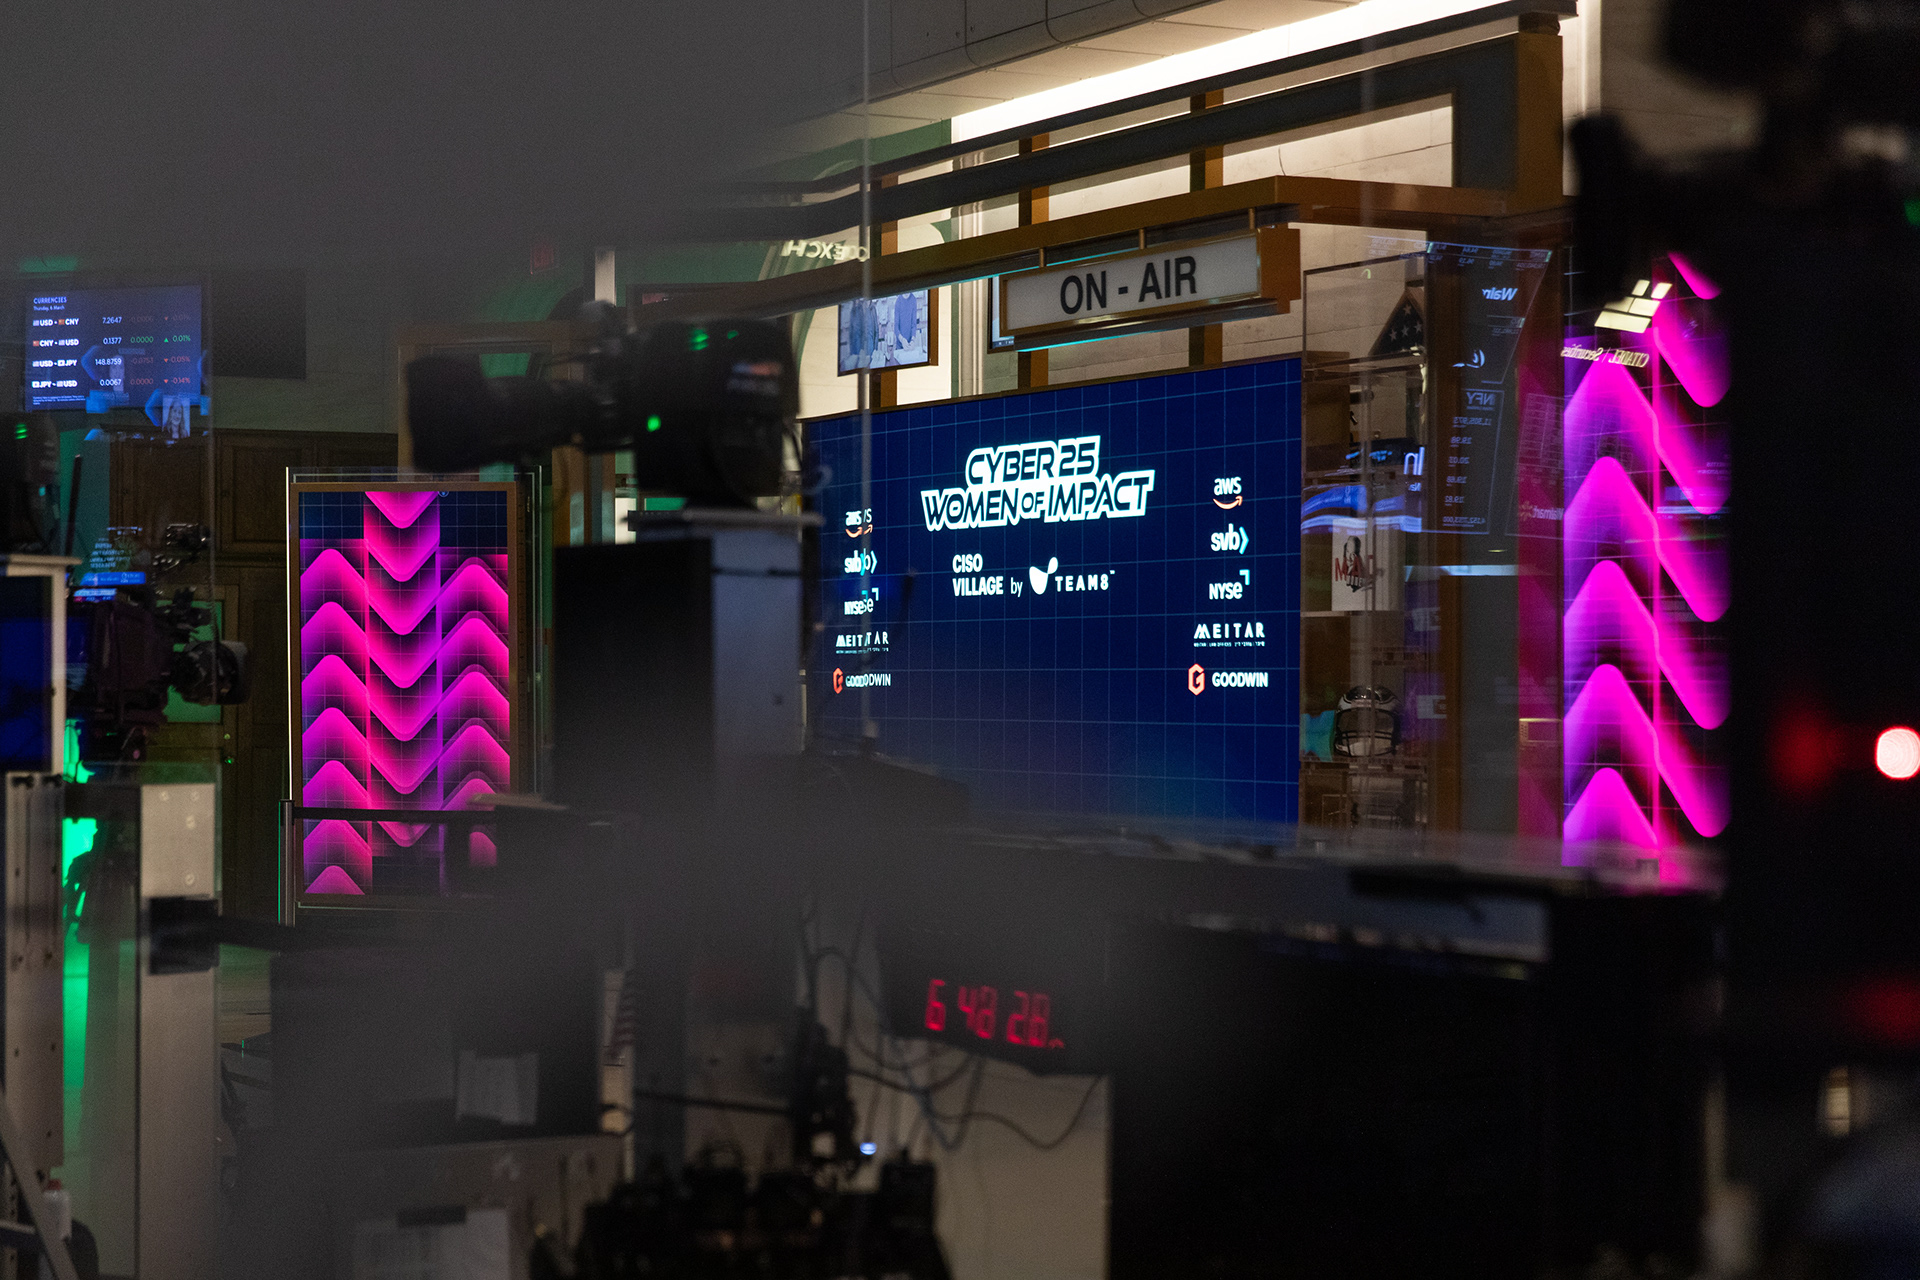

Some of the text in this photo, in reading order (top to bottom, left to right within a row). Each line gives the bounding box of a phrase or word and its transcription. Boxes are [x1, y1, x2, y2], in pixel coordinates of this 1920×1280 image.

[1060, 273, 1108, 315] ON
[1138, 255, 1197, 303] AIR
[34, 296, 67, 304] CURRENCIES
[40, 318, 54, 327] USD
[65, 318, 79, 326] CNY
[102, 316, 122, 324] 7.2647
[40, 339, 54, 347] CNY
[65, 338, 79, 346] USD
[102, 337, 122, 345] 0.1377
[172, 334, 191, 342] 0.01%
[40, 360, 54, 368] USD
[64, 359, 78, 367] JPY
[95, 358, 122, 366] 148.8759
[38, 380, 52, 388] JPY
[100, 378, 122, 386] 0.0067
[967, 436, 1101, 486] CYBER 25
[1214, 476, 1242, 496] aws
[921, 470, 1155, 531] WOMEN OF IMPACT
[1210, 524, 1240, 552] svb
[952, 553, 983, 572] CISO
[952, 575, 1110, 597] VILLAGE by TEAM8
[1193, 622, 1266, 640] MEITAR
[1212, 671, 1268, 688] GOODWIN
